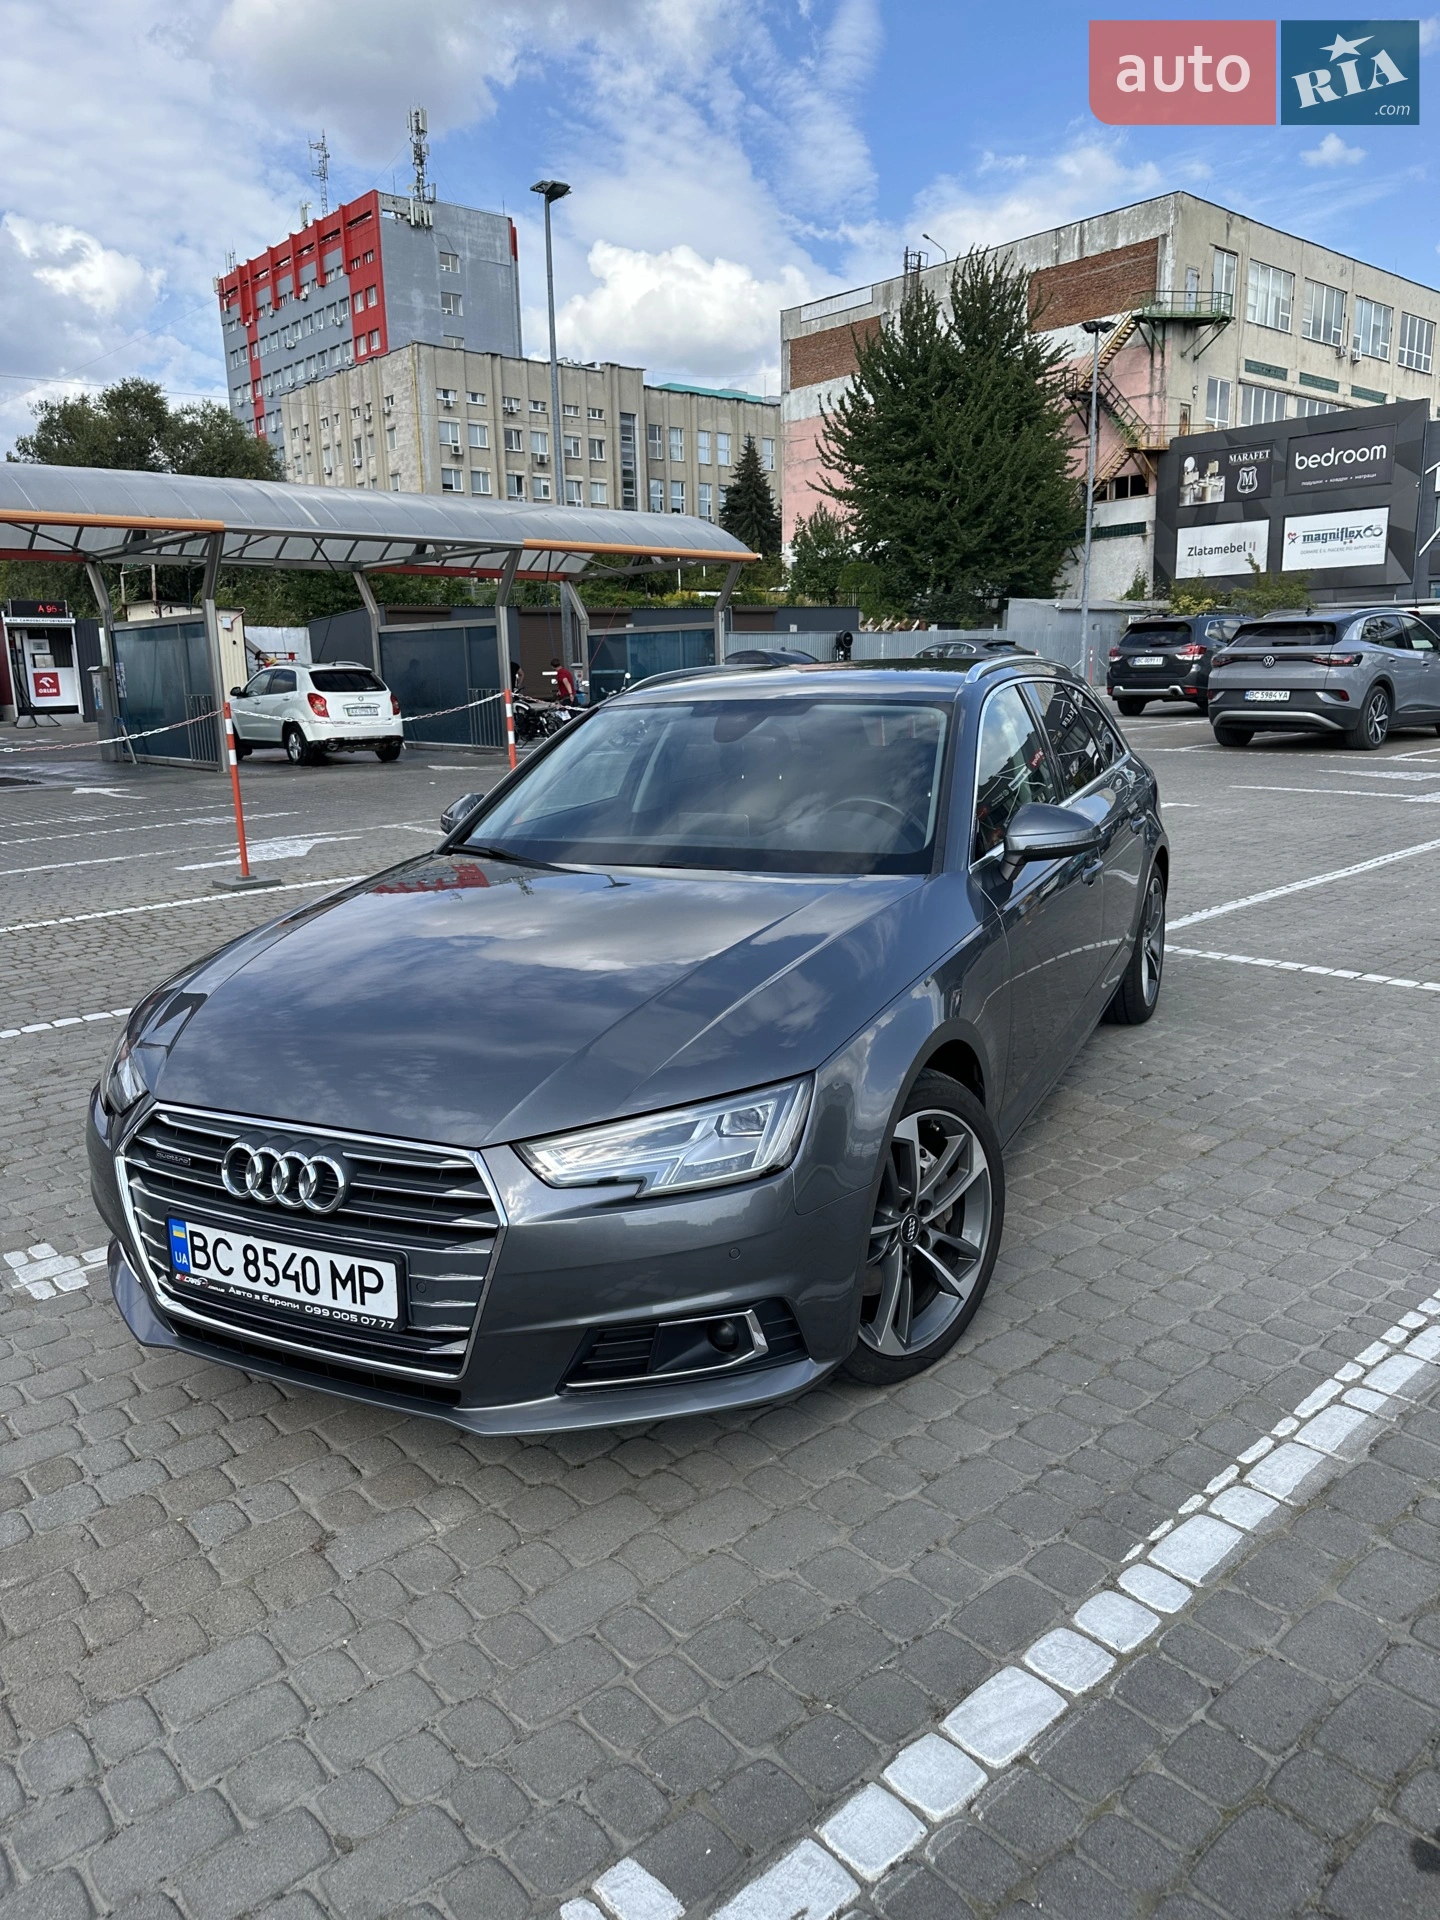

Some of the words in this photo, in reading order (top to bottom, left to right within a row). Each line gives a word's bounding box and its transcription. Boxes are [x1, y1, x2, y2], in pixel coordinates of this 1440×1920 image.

[1228, 449, 1270, 462] MARAFET
[1294, 444, 1387, 470] bedroom
[1302, 526, 1363, 544] magniflex
[1187, 541, 1247, 557] Zlatamebel
[1248, 691, 1260, 699] BC
[1260, 691, 1277, 699] 5984
[156, 1152, 189, 1164] quattro
[174, 1250, 189, 1266] UA
[188, 1228, 235, 1277] BC
[242, 1243, 321, 1296] 8540
[329, 1259, 384, 1306] MP
[228, 1286, 253, 1299] Авто
[262, 1294, 300, 1310] Європи
[304, 1304, 330, 1317] 099
[332, 1310, 358, 1323] 005
[360, 1316, 377, 1327] 07
[379, 1320, 395, 1330] 77
